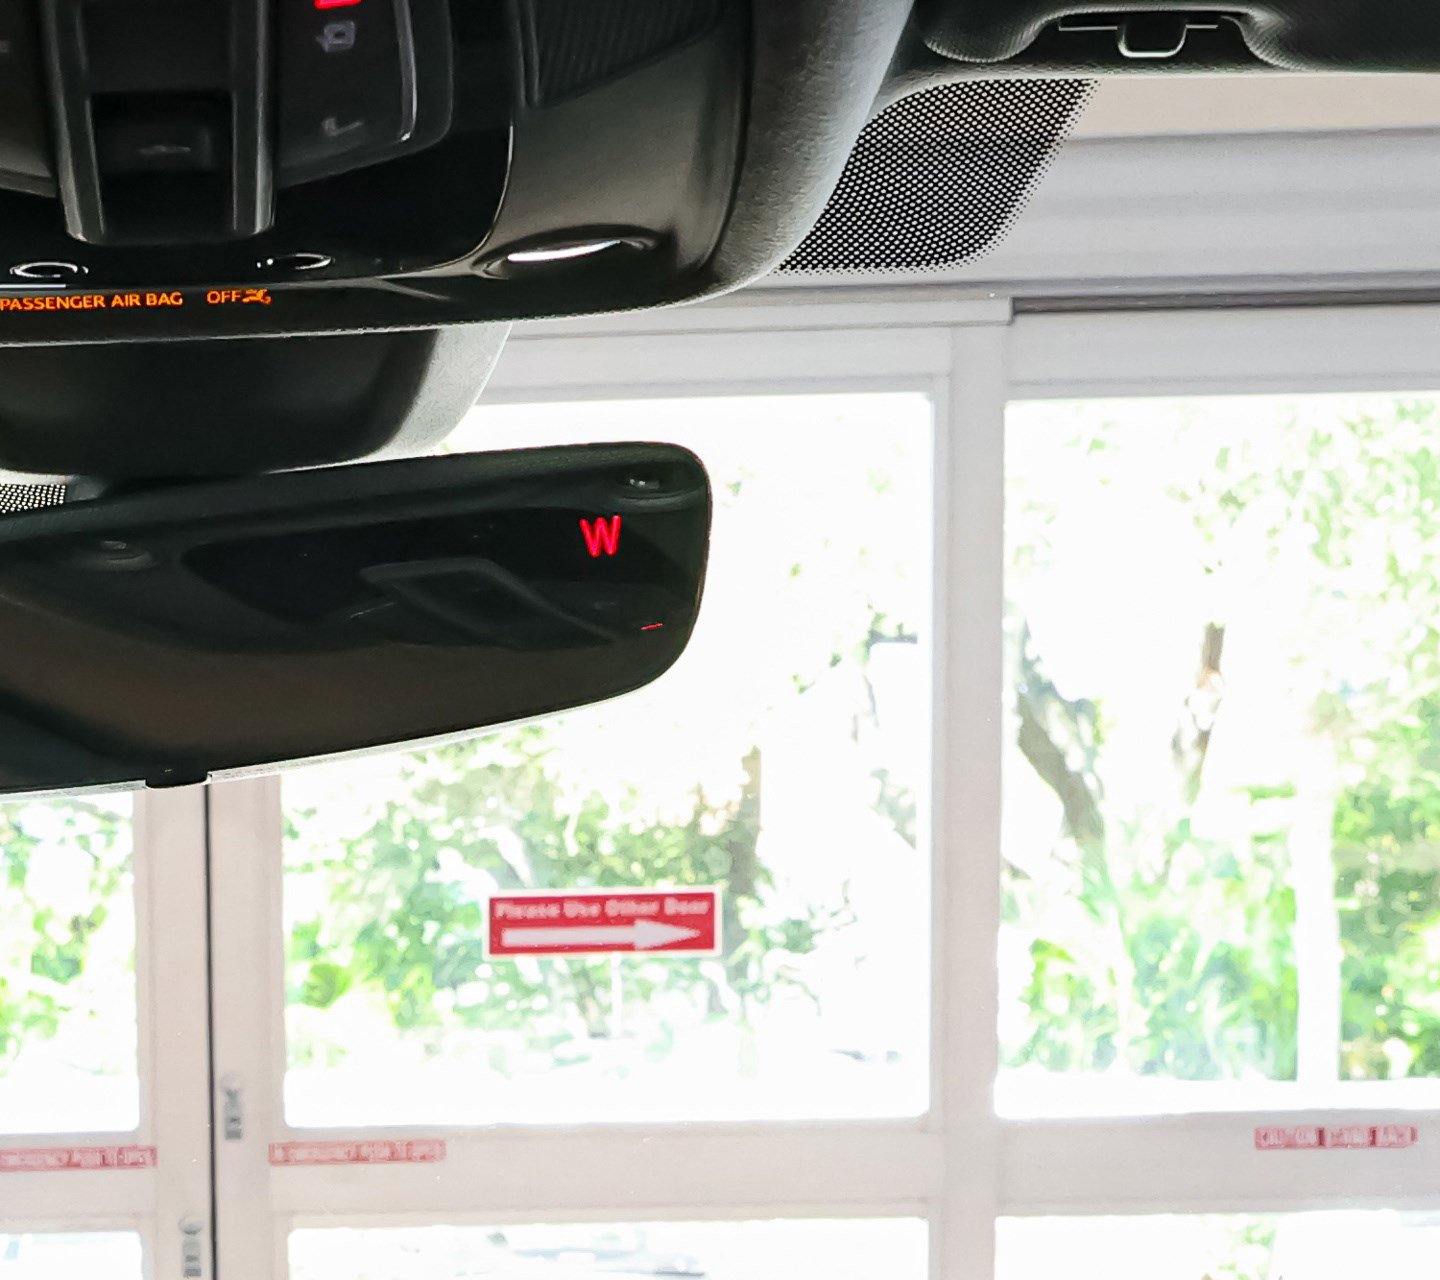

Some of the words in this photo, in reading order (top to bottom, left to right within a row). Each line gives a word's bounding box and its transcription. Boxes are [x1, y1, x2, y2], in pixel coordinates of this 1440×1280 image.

[0, 297, 106, 310] PASSENGER
[111, 293, 141, 307] AIR
[146, 292, 182, 306] BAG
[207, 290, 241, 304] OFF
[580, 516, 621, 557] W
